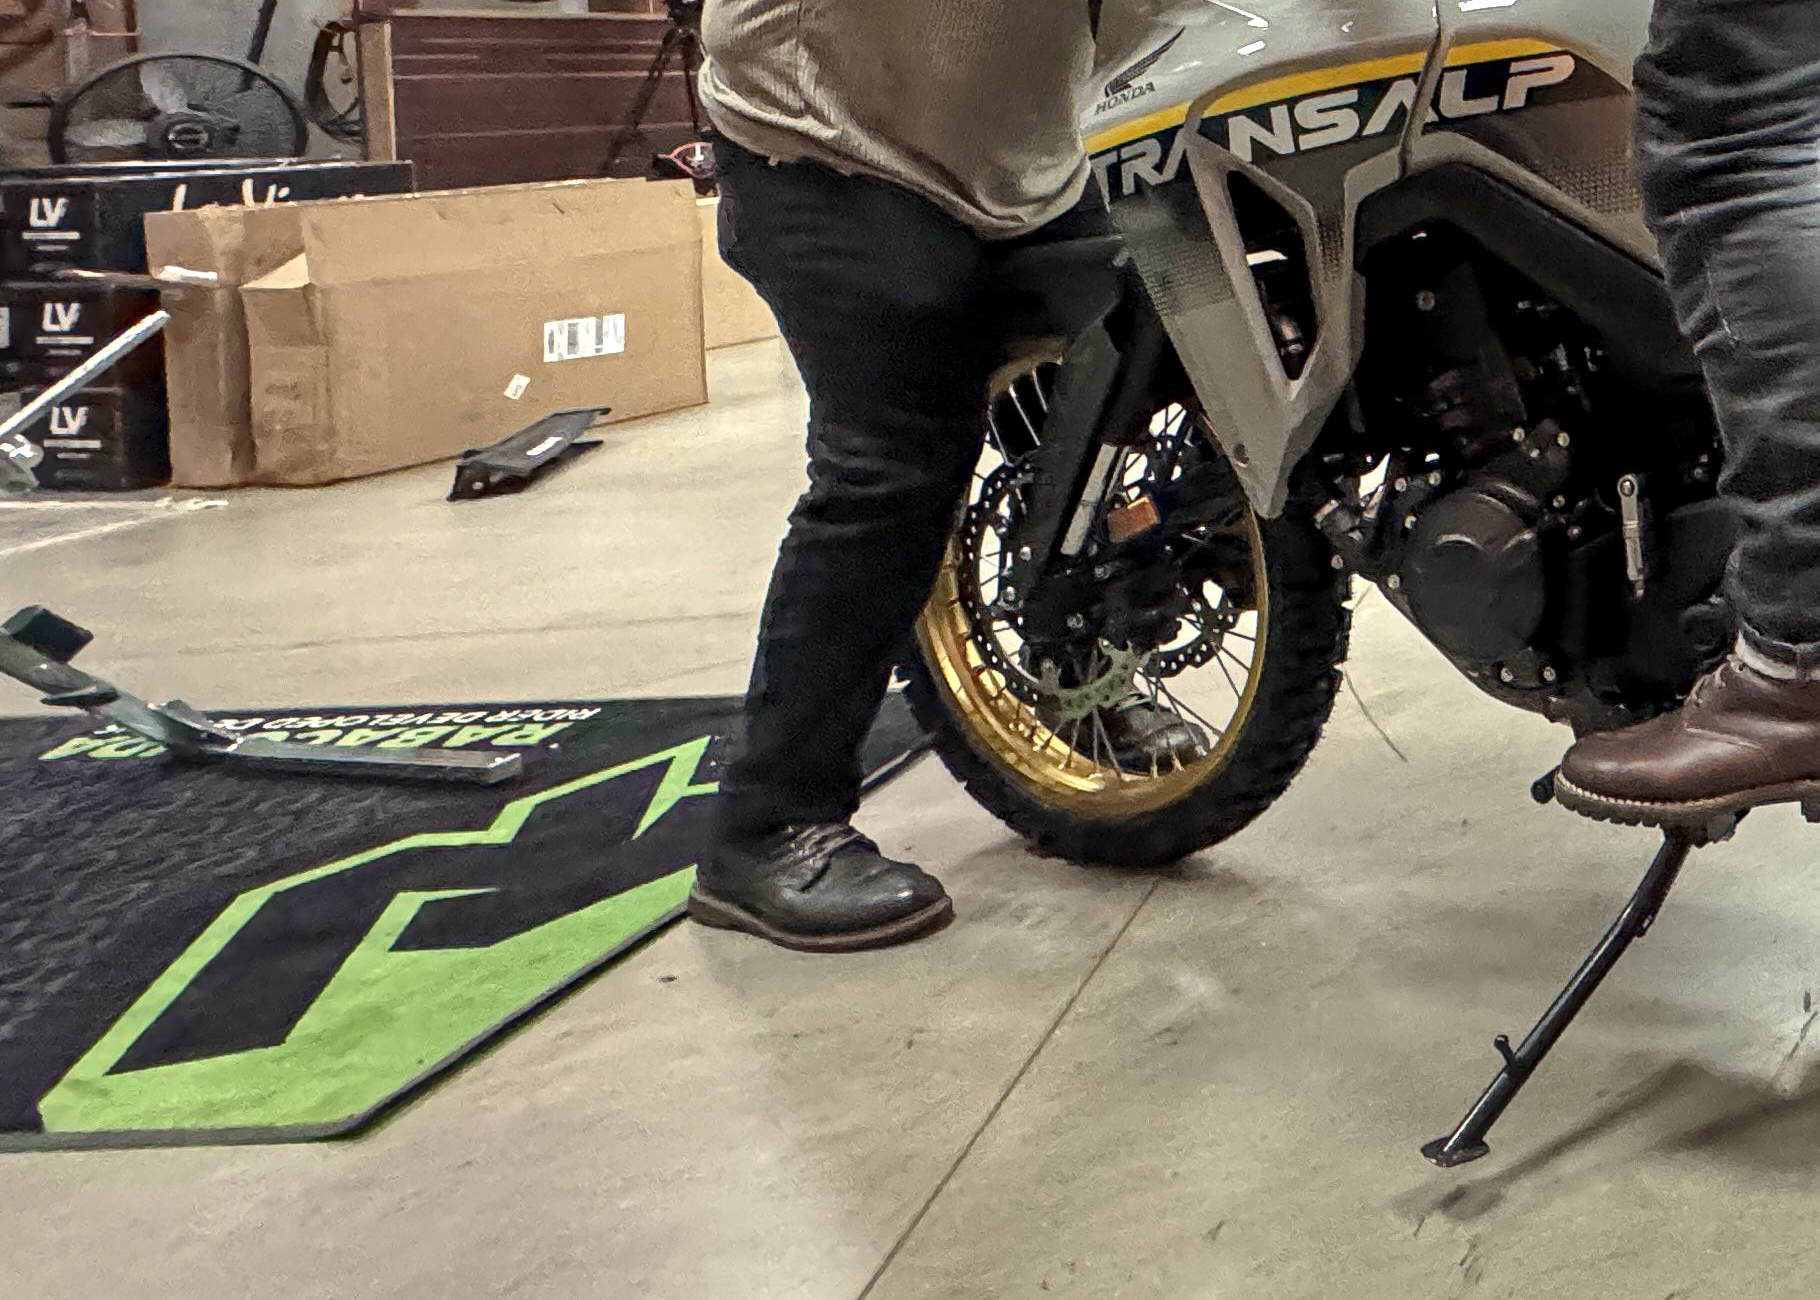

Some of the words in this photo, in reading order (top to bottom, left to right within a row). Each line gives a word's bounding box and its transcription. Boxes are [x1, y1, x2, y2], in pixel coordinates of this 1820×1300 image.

[1094, 81, 1156, 116] HONDA
[484, 707, 601, 724] RIDER
[38, 721, 575, 761] RABACDA
